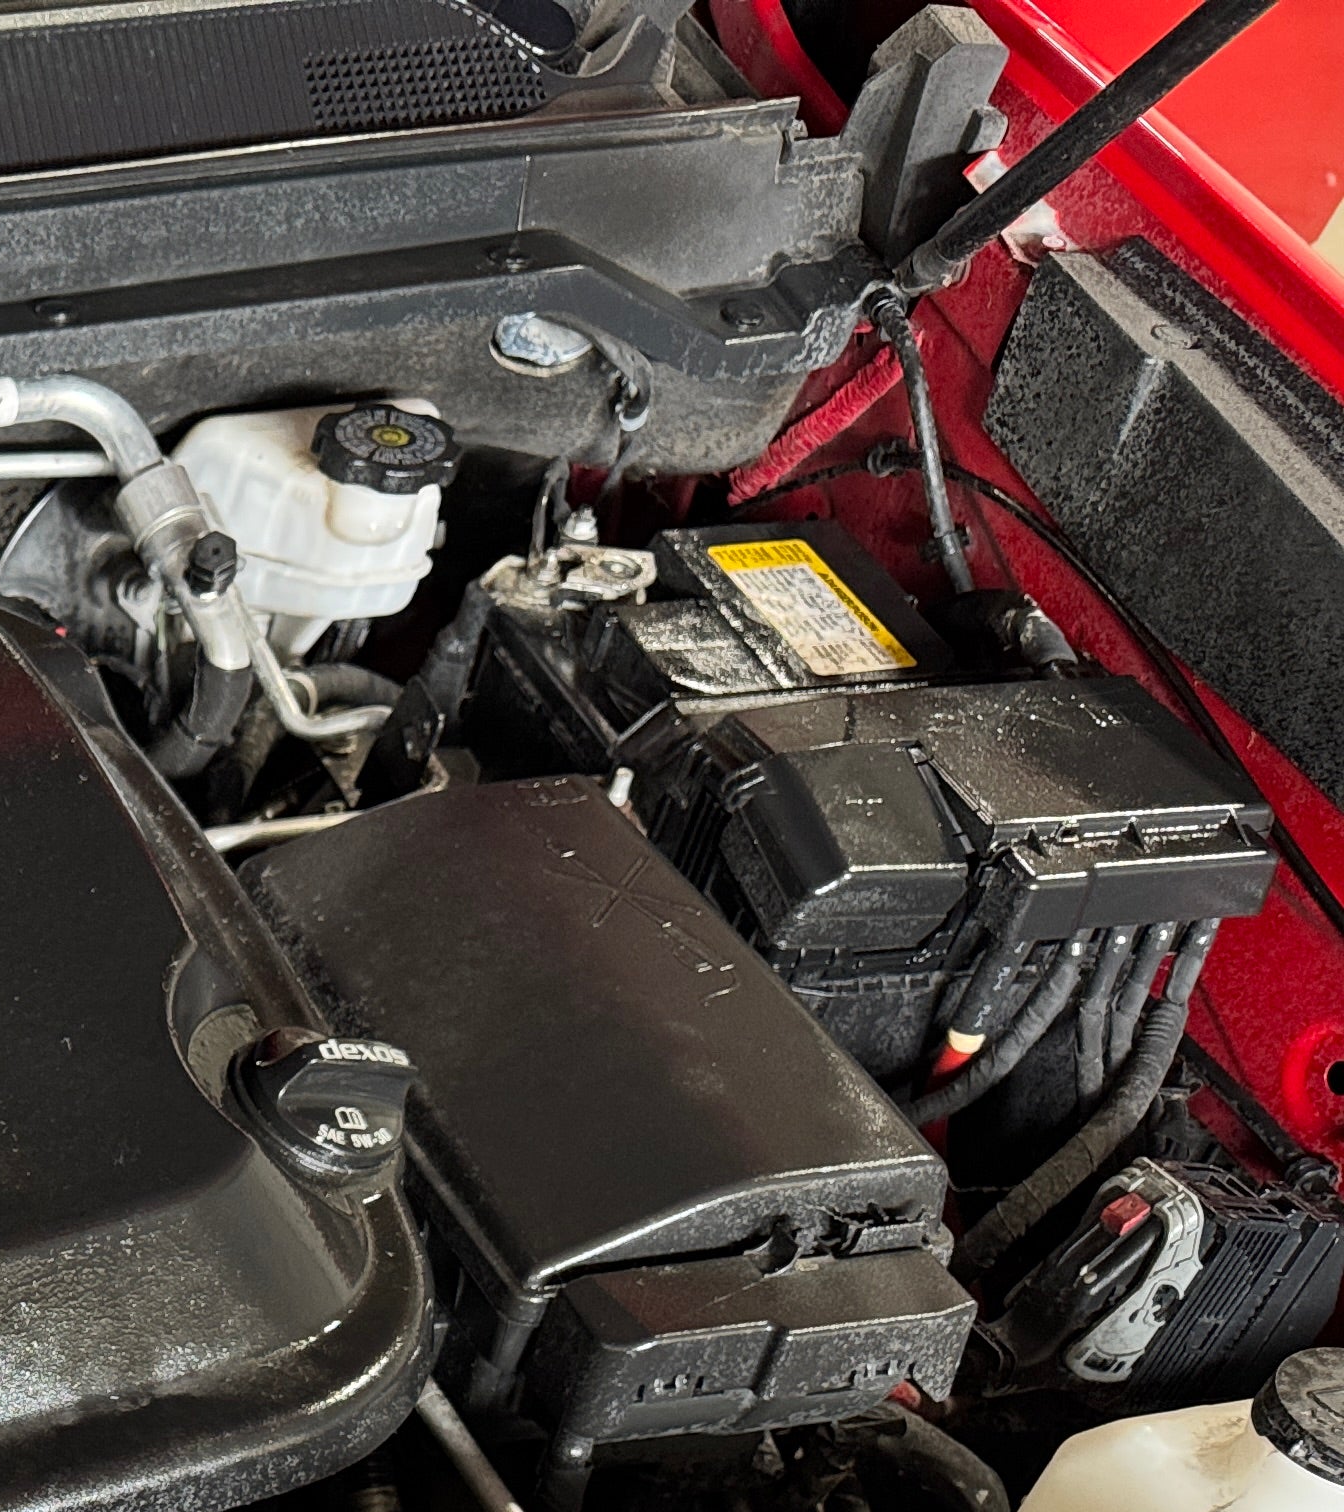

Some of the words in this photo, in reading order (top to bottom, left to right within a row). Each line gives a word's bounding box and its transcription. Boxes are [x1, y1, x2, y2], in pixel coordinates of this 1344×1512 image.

[318, 1038, 411, 1067] dexos
[315, 1123, 346, 1146] SAE
[350, 1127, 393, 1149] 5W-30
